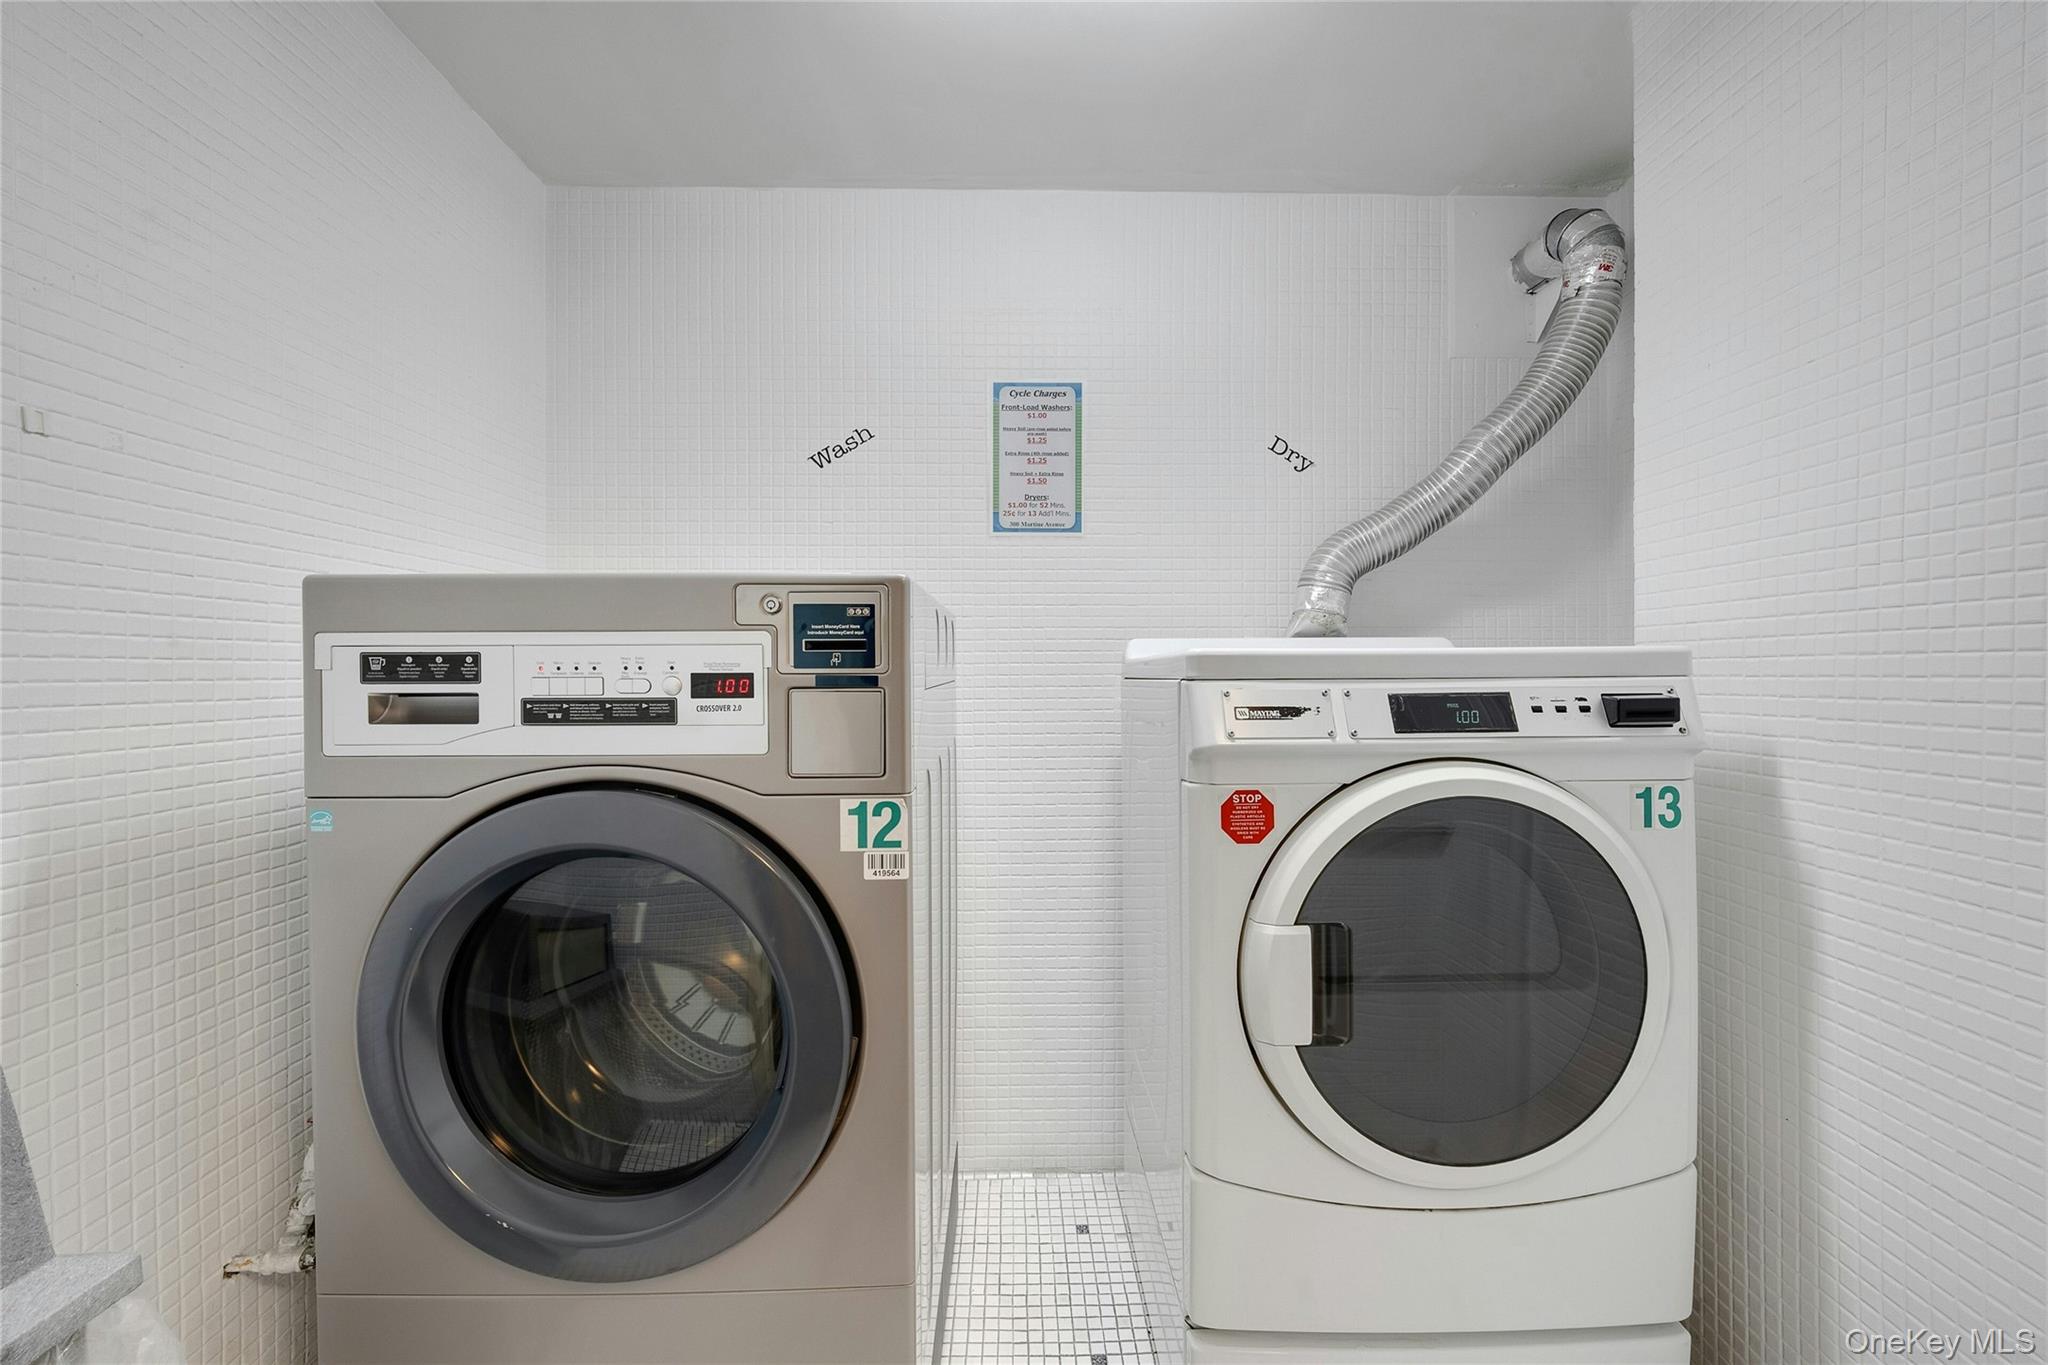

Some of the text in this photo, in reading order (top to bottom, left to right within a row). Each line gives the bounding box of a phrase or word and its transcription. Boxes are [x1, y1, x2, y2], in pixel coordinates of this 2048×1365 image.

[1009, 389, 1067, 399] Cycle Charges
[807, 428, 875, 469] Wash
[1268, 435, 1314, 472] Dry
[717, 679, 749, 693] 1.00
[1456, 710, 1479, 723] 1.00
[1232, 794, 1262, 803] STOP
[1636, 786, 1681, 828] 13
[848, 801, 902, 848] 12
